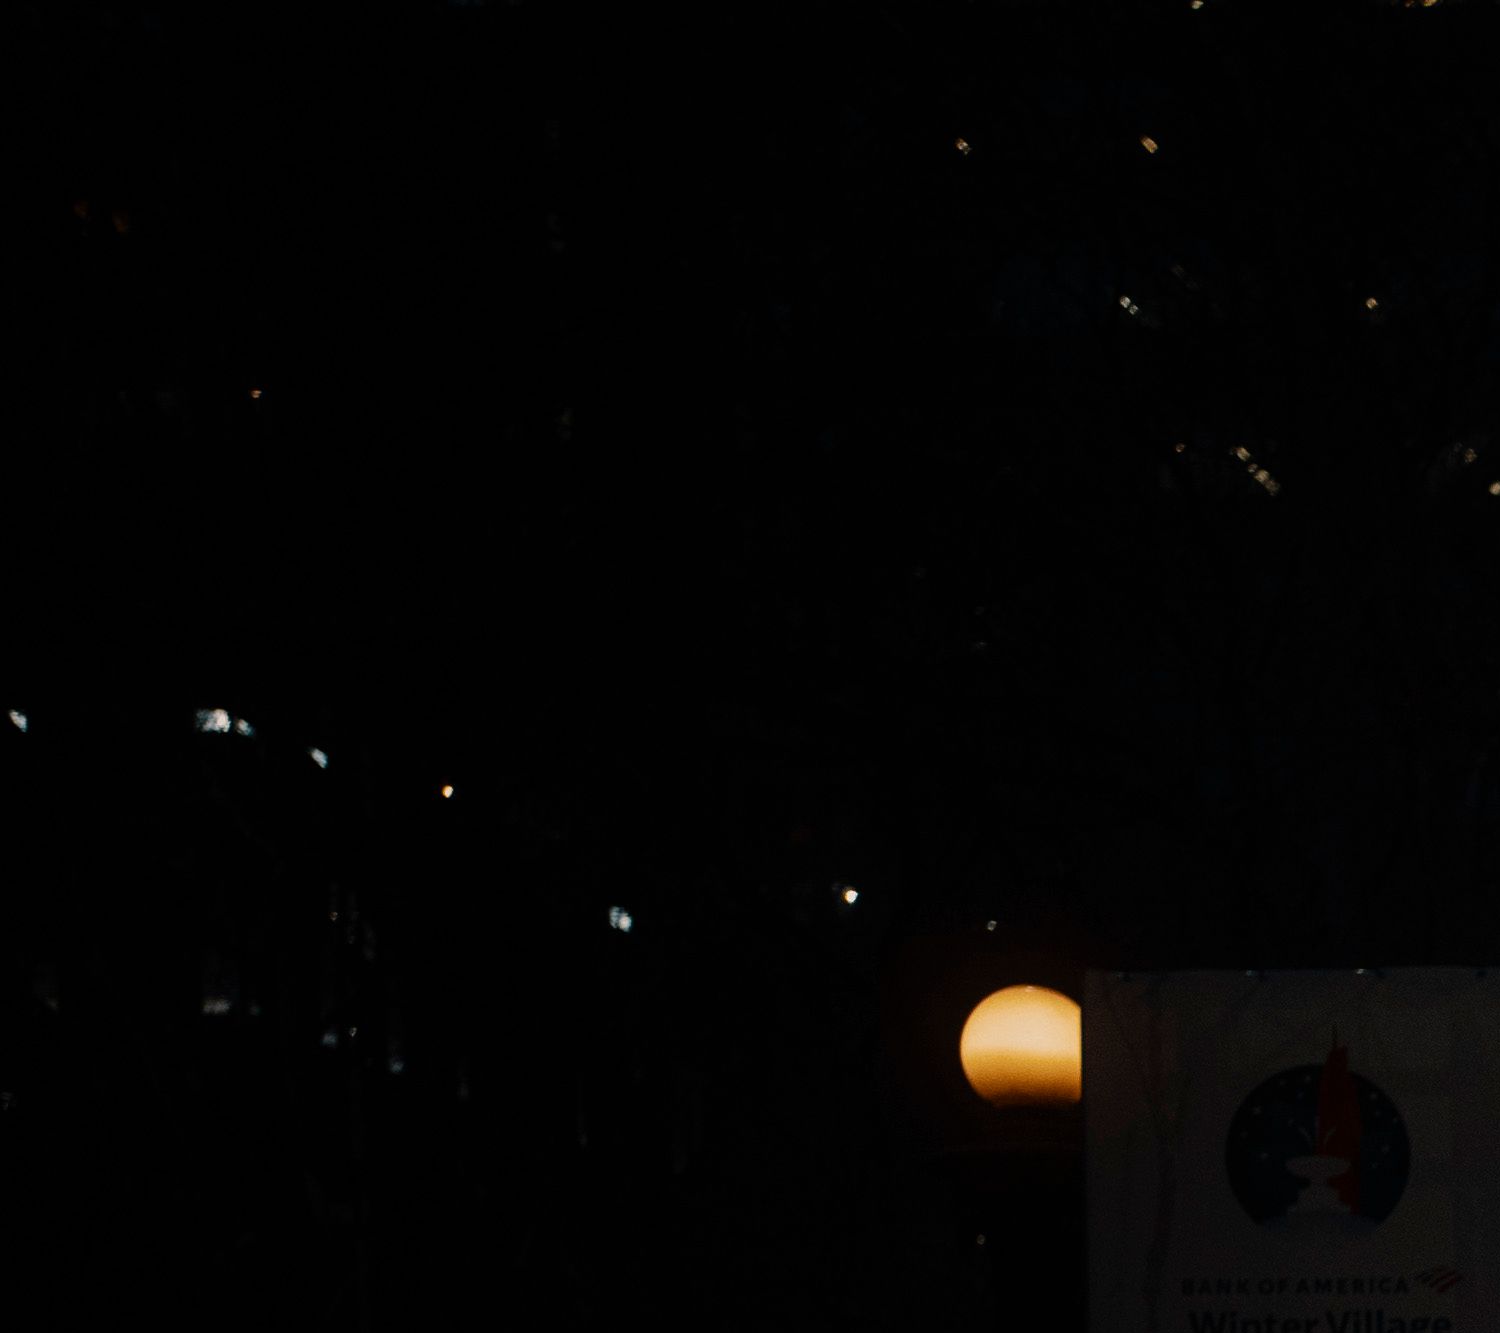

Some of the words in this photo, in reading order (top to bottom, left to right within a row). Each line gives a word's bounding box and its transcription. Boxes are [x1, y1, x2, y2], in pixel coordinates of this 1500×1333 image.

[1181, 1278, 1249, 1295] BANK
[1256, 1278, 1288, 1295] OF
[1296, 1278, 1409, 1295] AMERICA
